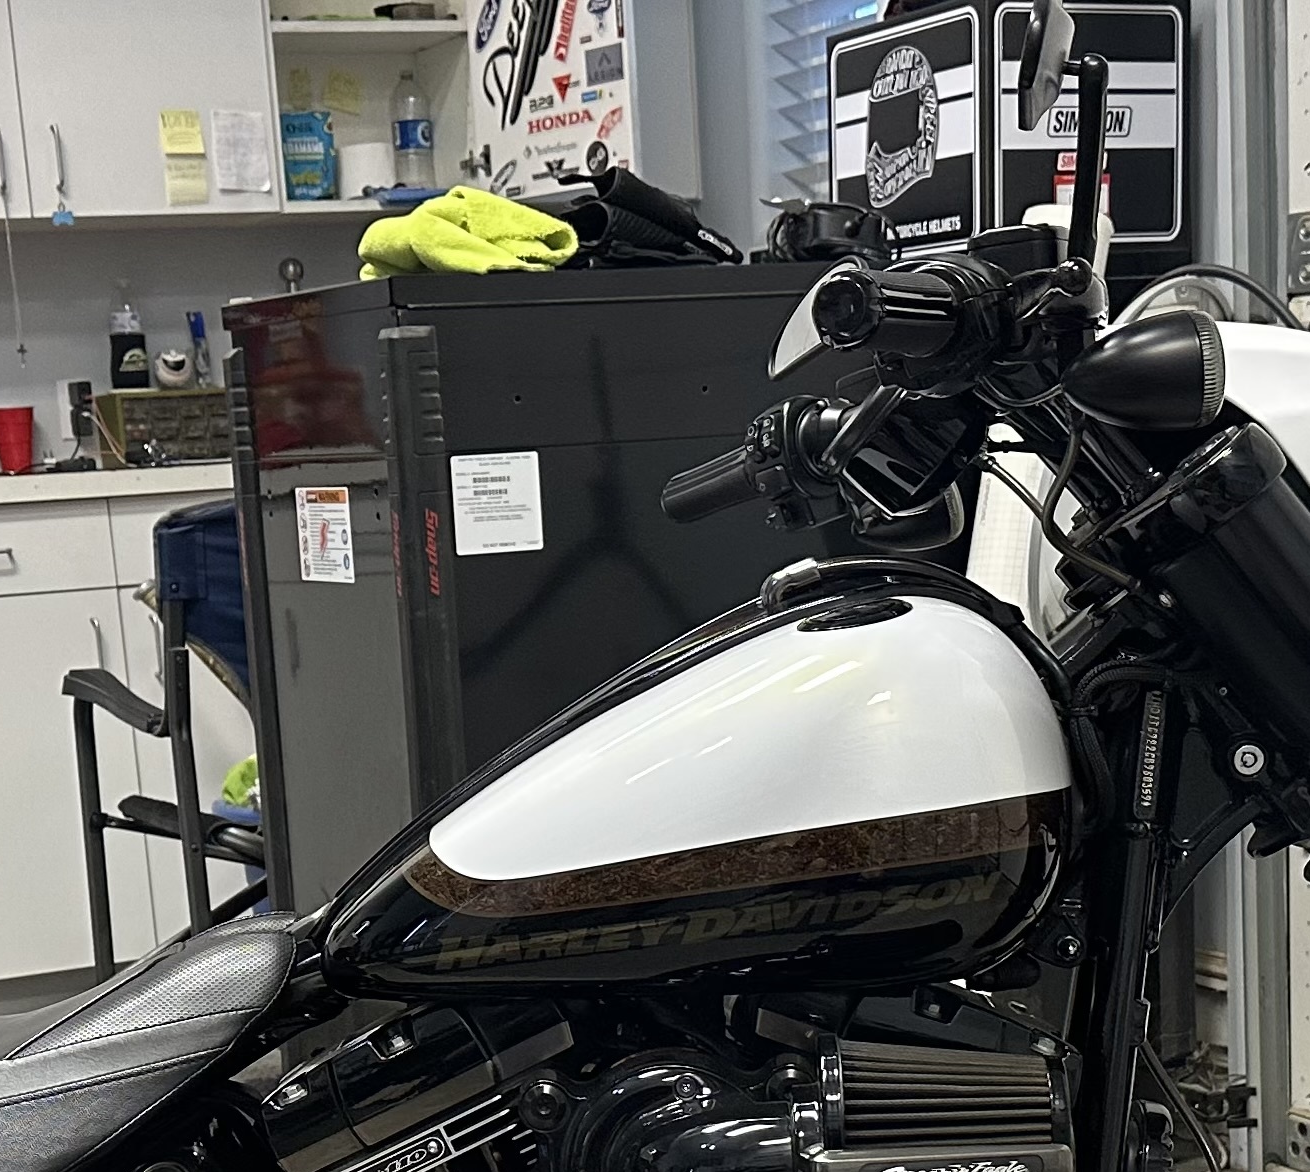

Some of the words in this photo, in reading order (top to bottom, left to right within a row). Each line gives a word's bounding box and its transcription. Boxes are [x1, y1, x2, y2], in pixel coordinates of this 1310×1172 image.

[527, 109, 594, 135] HONDA
[1053, 110, 1125, 133] SIMON
[425, 507, 441, 597] Snap-on
[436, 877, 999, 971] HARLEY-DAVIDSON
